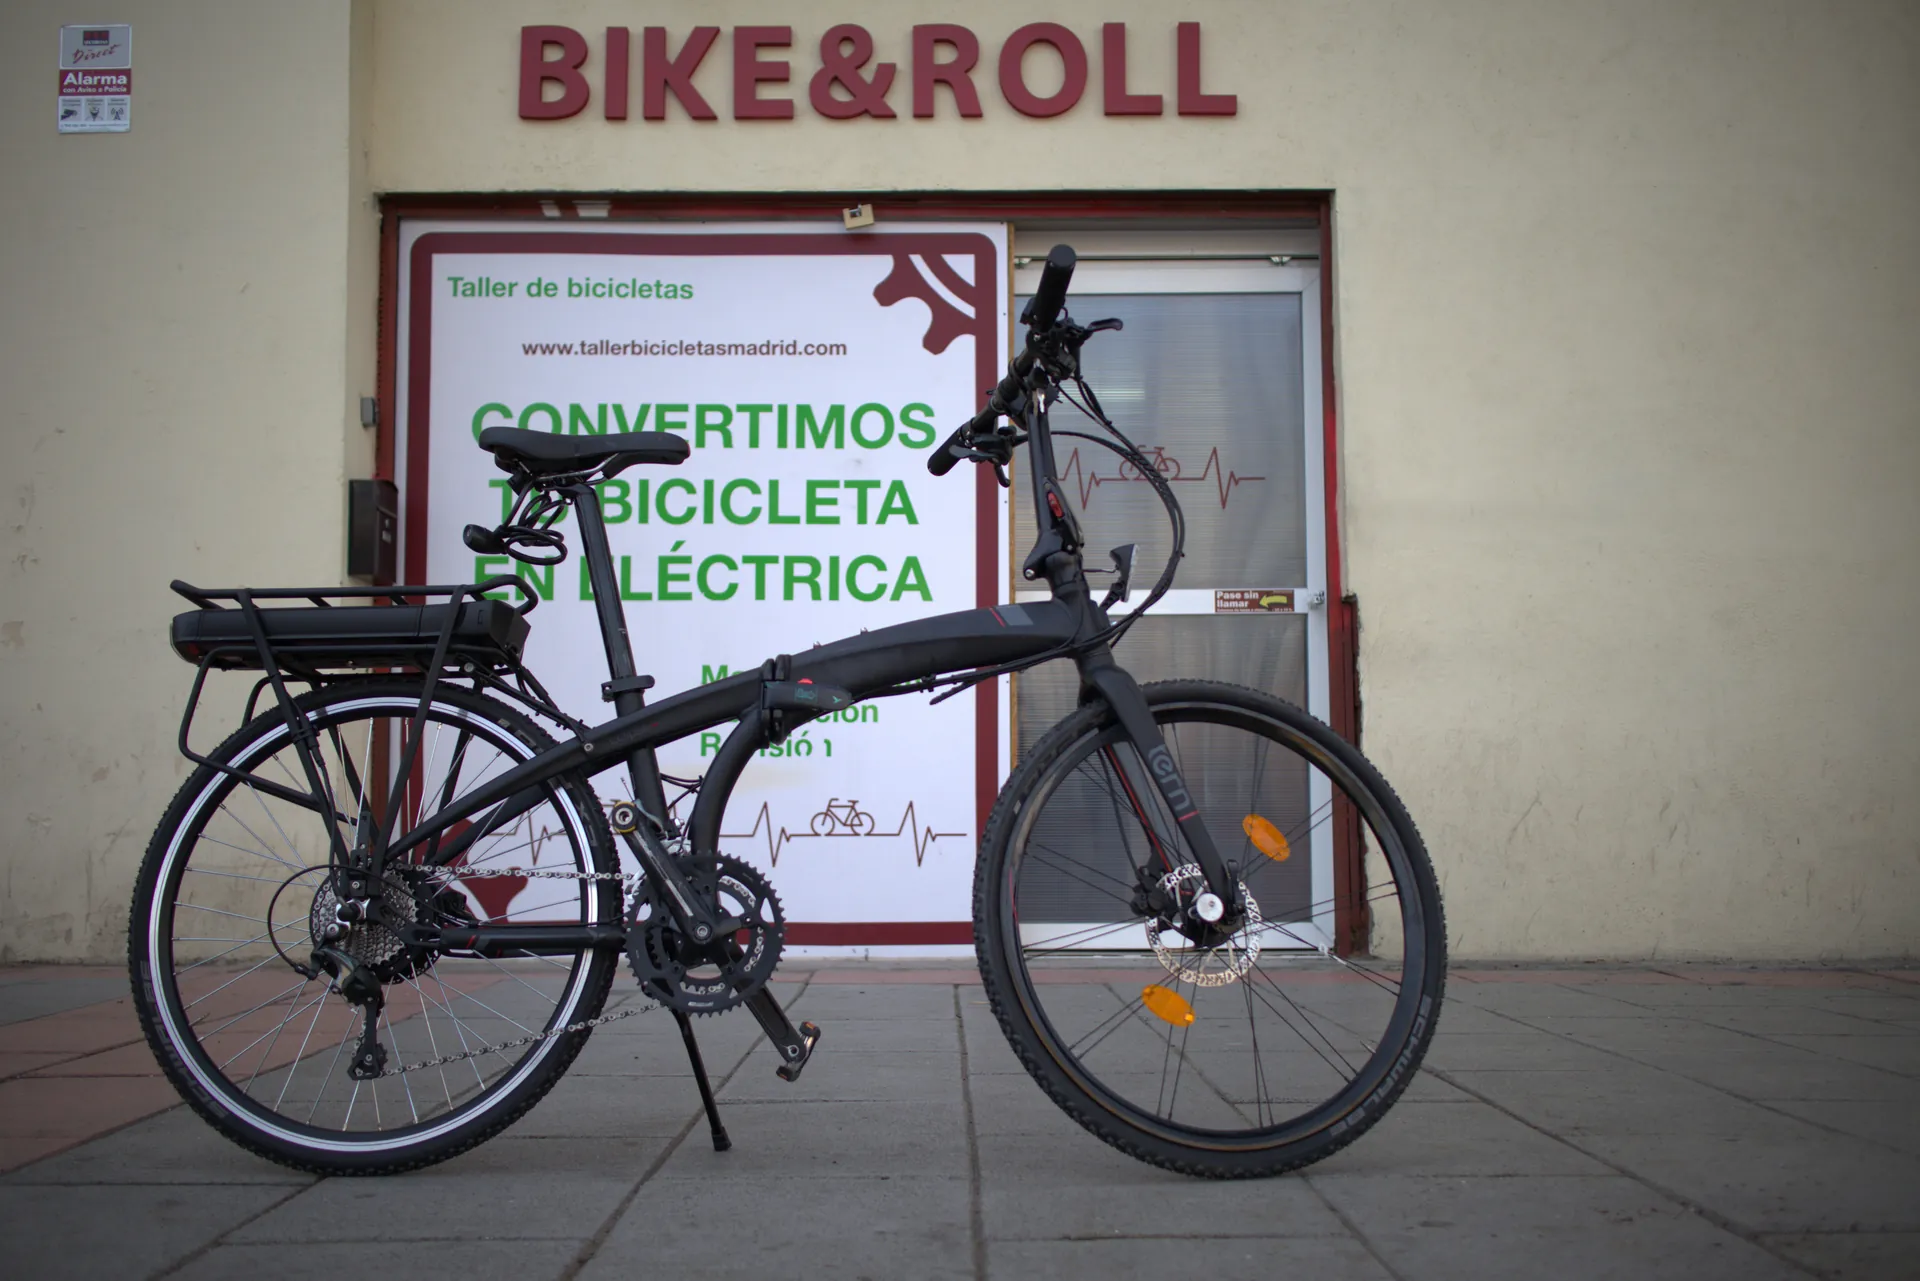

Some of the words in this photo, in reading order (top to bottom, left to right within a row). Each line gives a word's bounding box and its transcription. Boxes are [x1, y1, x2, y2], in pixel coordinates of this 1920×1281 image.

[72, 43, 122, 64] Direct
[63, 72, 128, 85] Alarma
[519, 22, 1238, 121] BIKE&ROLL
[447, 277, 518, 297] Taller
[525, 278, 559, 297] de
[567, 279, 694, 299] bicicletas
[522, 339, 848, 356] www.tallerbicicletasmadrid.com
[594, 479, 919, 526] BICICLETA
[1216, 590, 1242, 599] Paso
[1243, 589, 1259, 599] sin
[1216, 600, 1249, 608] llamar
[139, 959, 229, 1119] SCHWALBE
[1329, 994, 1433, 1137] SCHWALBE
